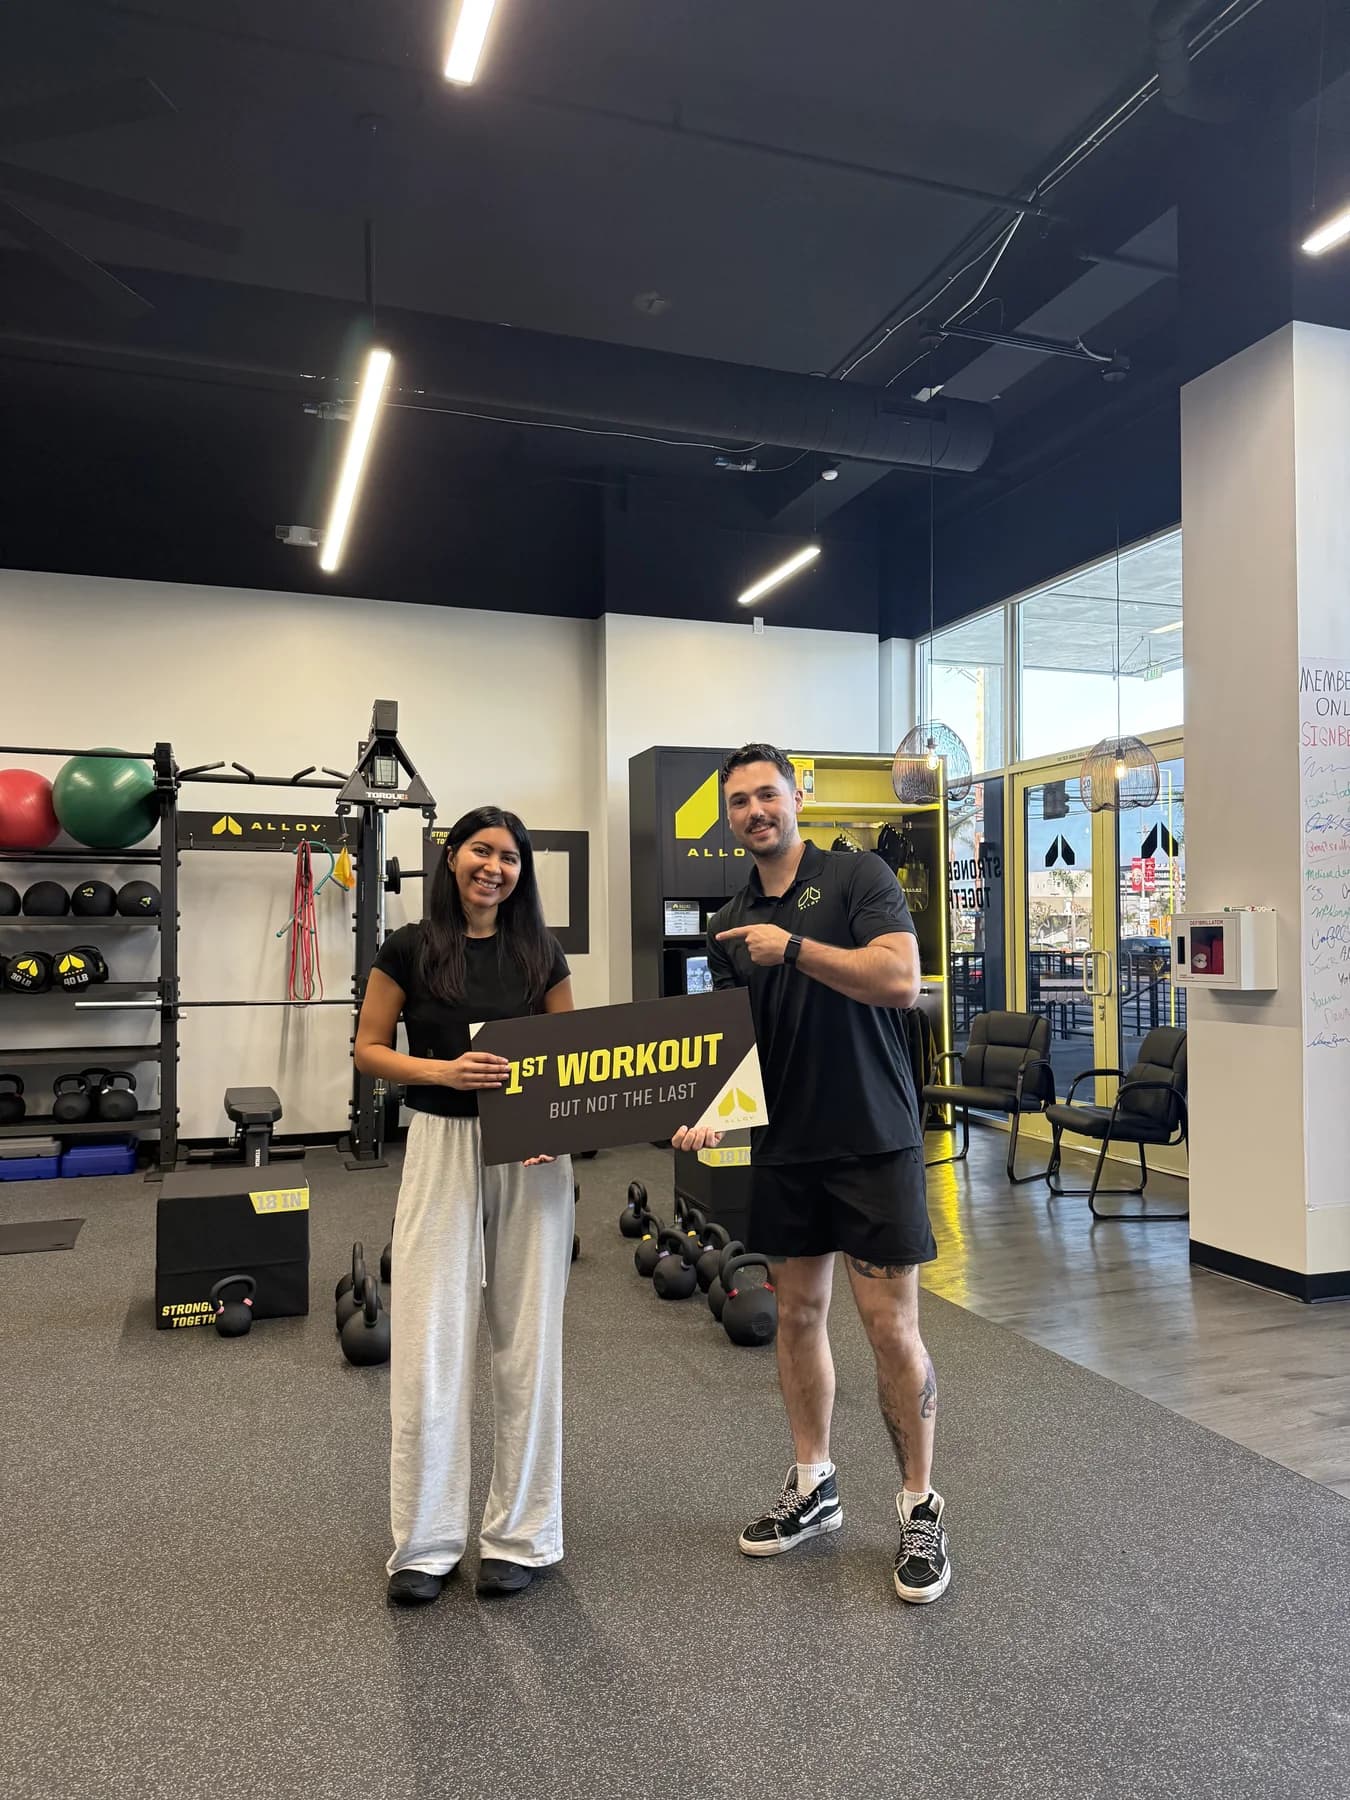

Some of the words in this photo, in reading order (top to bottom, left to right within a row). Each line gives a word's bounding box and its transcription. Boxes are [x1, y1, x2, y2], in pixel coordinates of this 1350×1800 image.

[366, 791, 404, 800] TORQUE
[251, 822, 321, 831] ALLOY
[687, 848, 746, 857] ALLO
[63, 978, 76, 986] 40
[77, 973, 89, 983] LB
[557, 1033, 724, 1087] WORKOUT
[550, 1099, 581, 1119] BUT
[586, 1094, 617, 1114] NOT
[623, 1088, 653, 1108] THE
[659, 1082, 697, 1103] LAST
[256, 1195, 278, 1212] 18
[281, 1192, 301, 1208] IN
[162, 1300, 222, 1316] STRONG
